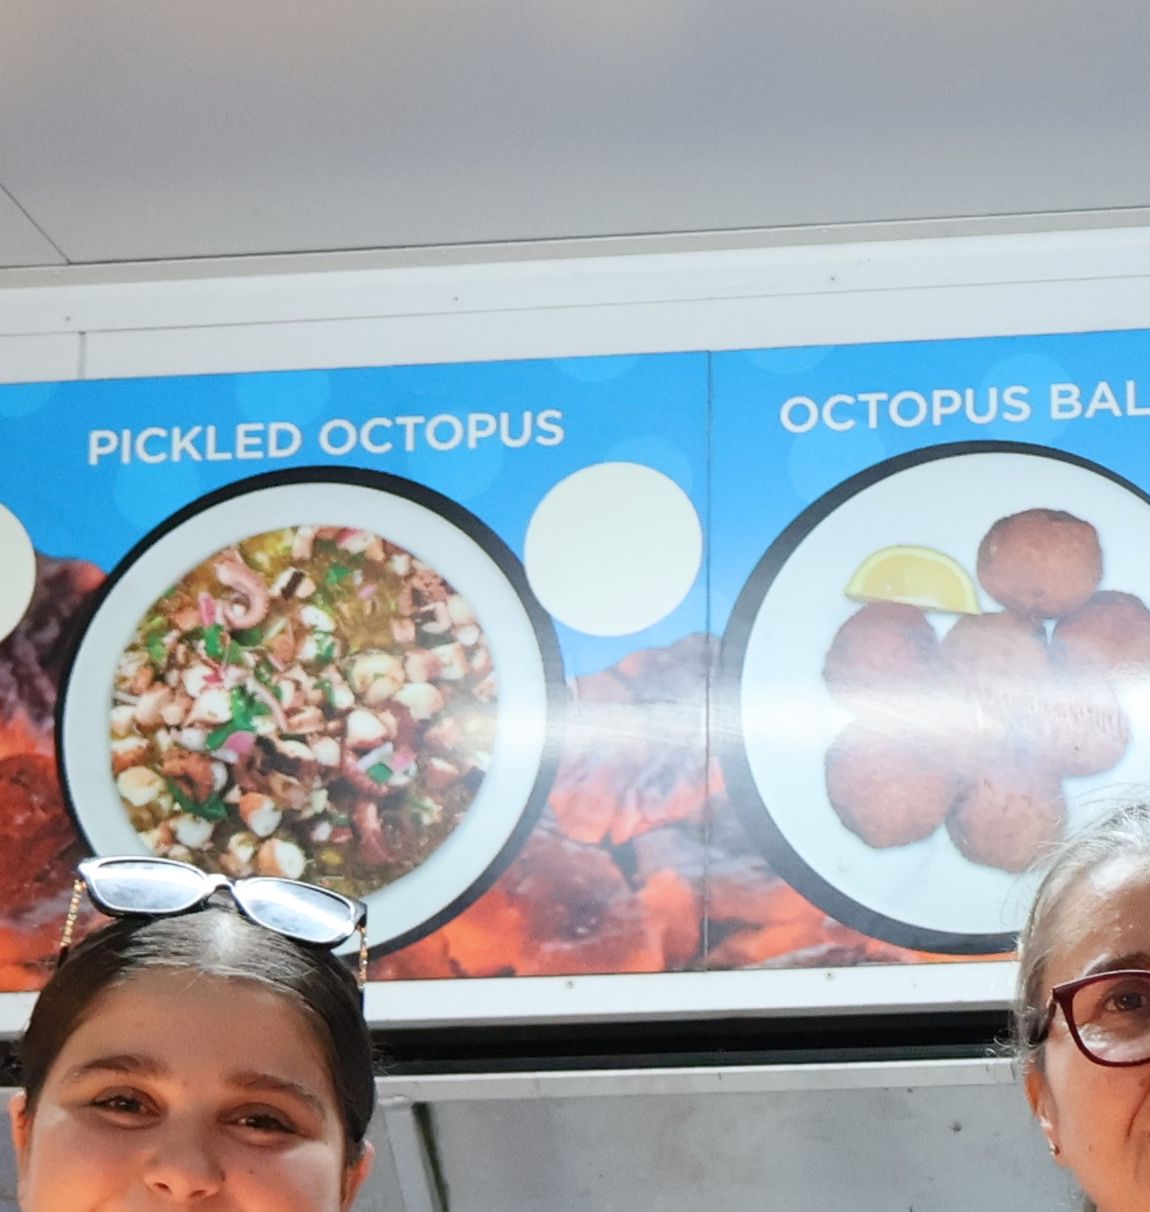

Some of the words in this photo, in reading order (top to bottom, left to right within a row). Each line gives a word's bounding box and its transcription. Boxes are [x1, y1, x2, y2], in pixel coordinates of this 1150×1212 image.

[779, 384, 1032, 434] OCTOPUS
[88, 421, 302, 466] PICKLED
[318, 408, 566, 457] OCTOPUS
